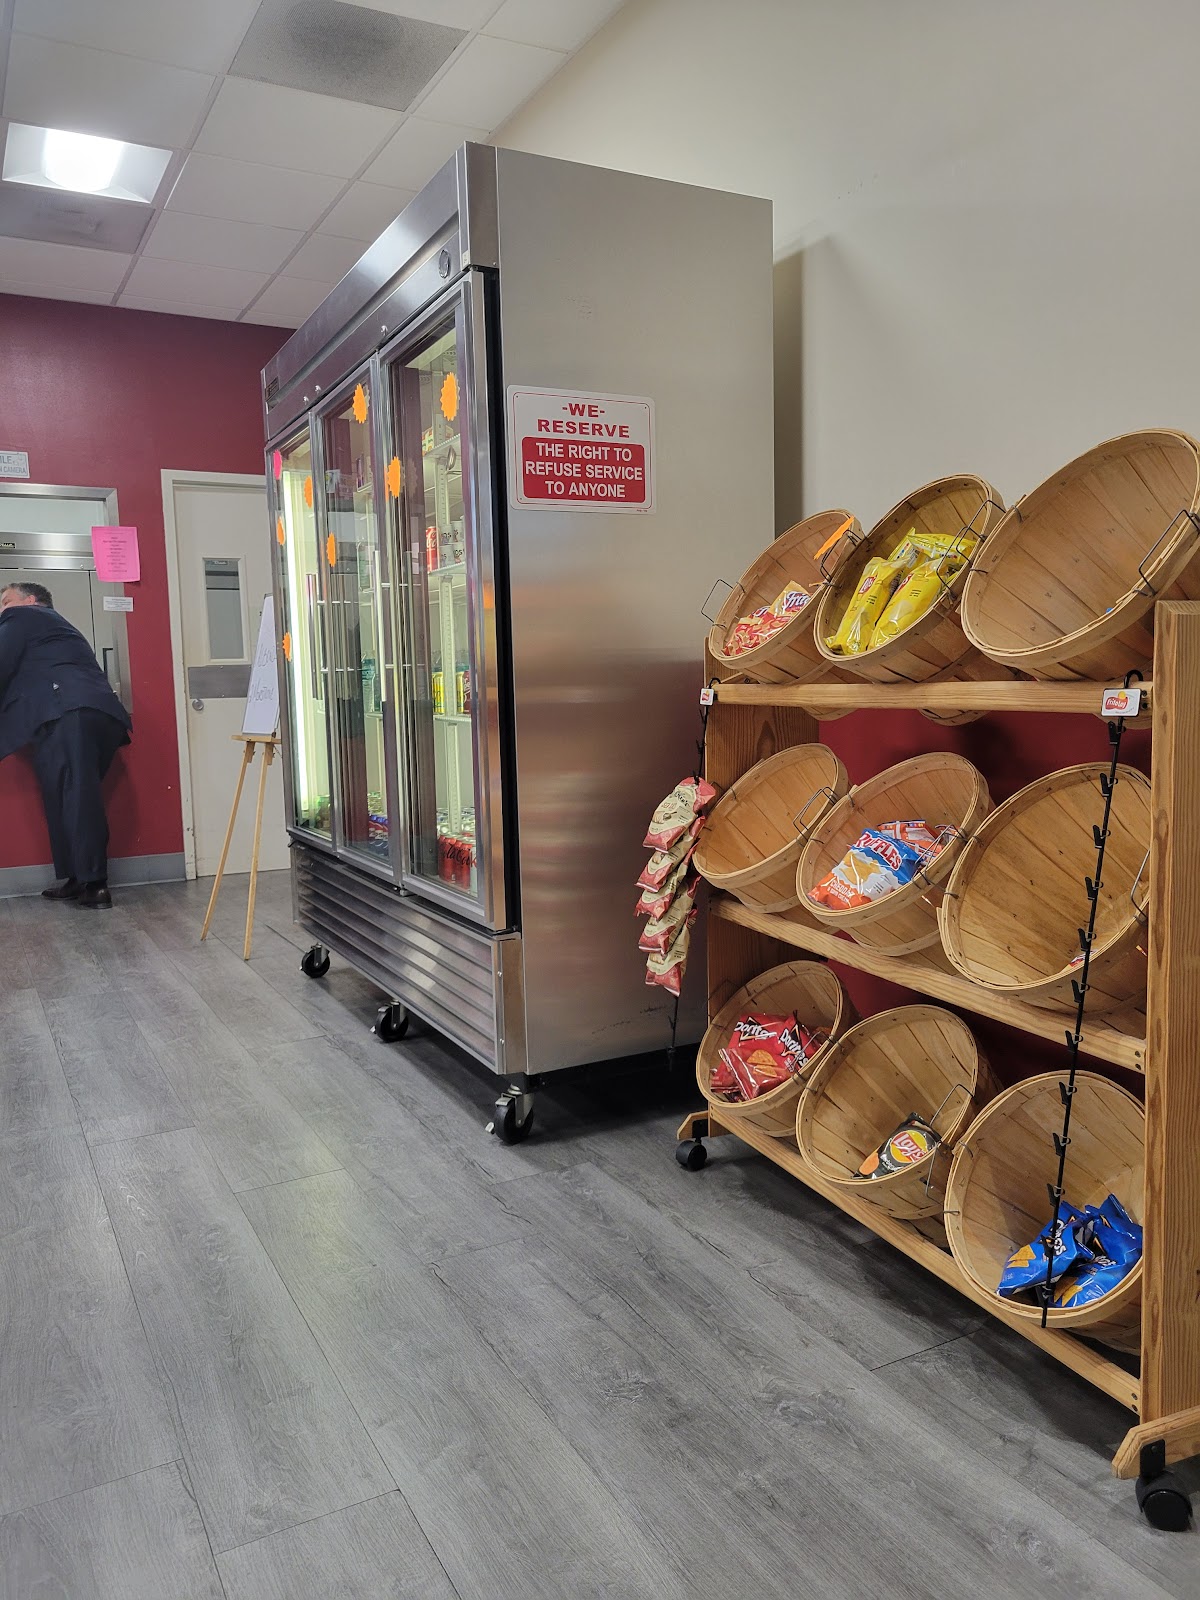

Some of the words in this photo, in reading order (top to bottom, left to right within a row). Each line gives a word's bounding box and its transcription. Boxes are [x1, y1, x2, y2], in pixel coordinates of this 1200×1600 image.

[537, 418, 630, 439] RESERVE
[536, 442, 564, 458] THE
[568, 445, 610, 460] RIGHT
[614, 447, 632, 462] TO
[525, 461, 582, 477] REFUSE
[585, 464, 643, 481] SERVICE
[545, 481, 565, 495] TO
[568, 482, 626, 498] ANYONE
[855, 831, 903, 871] RUFFLES
